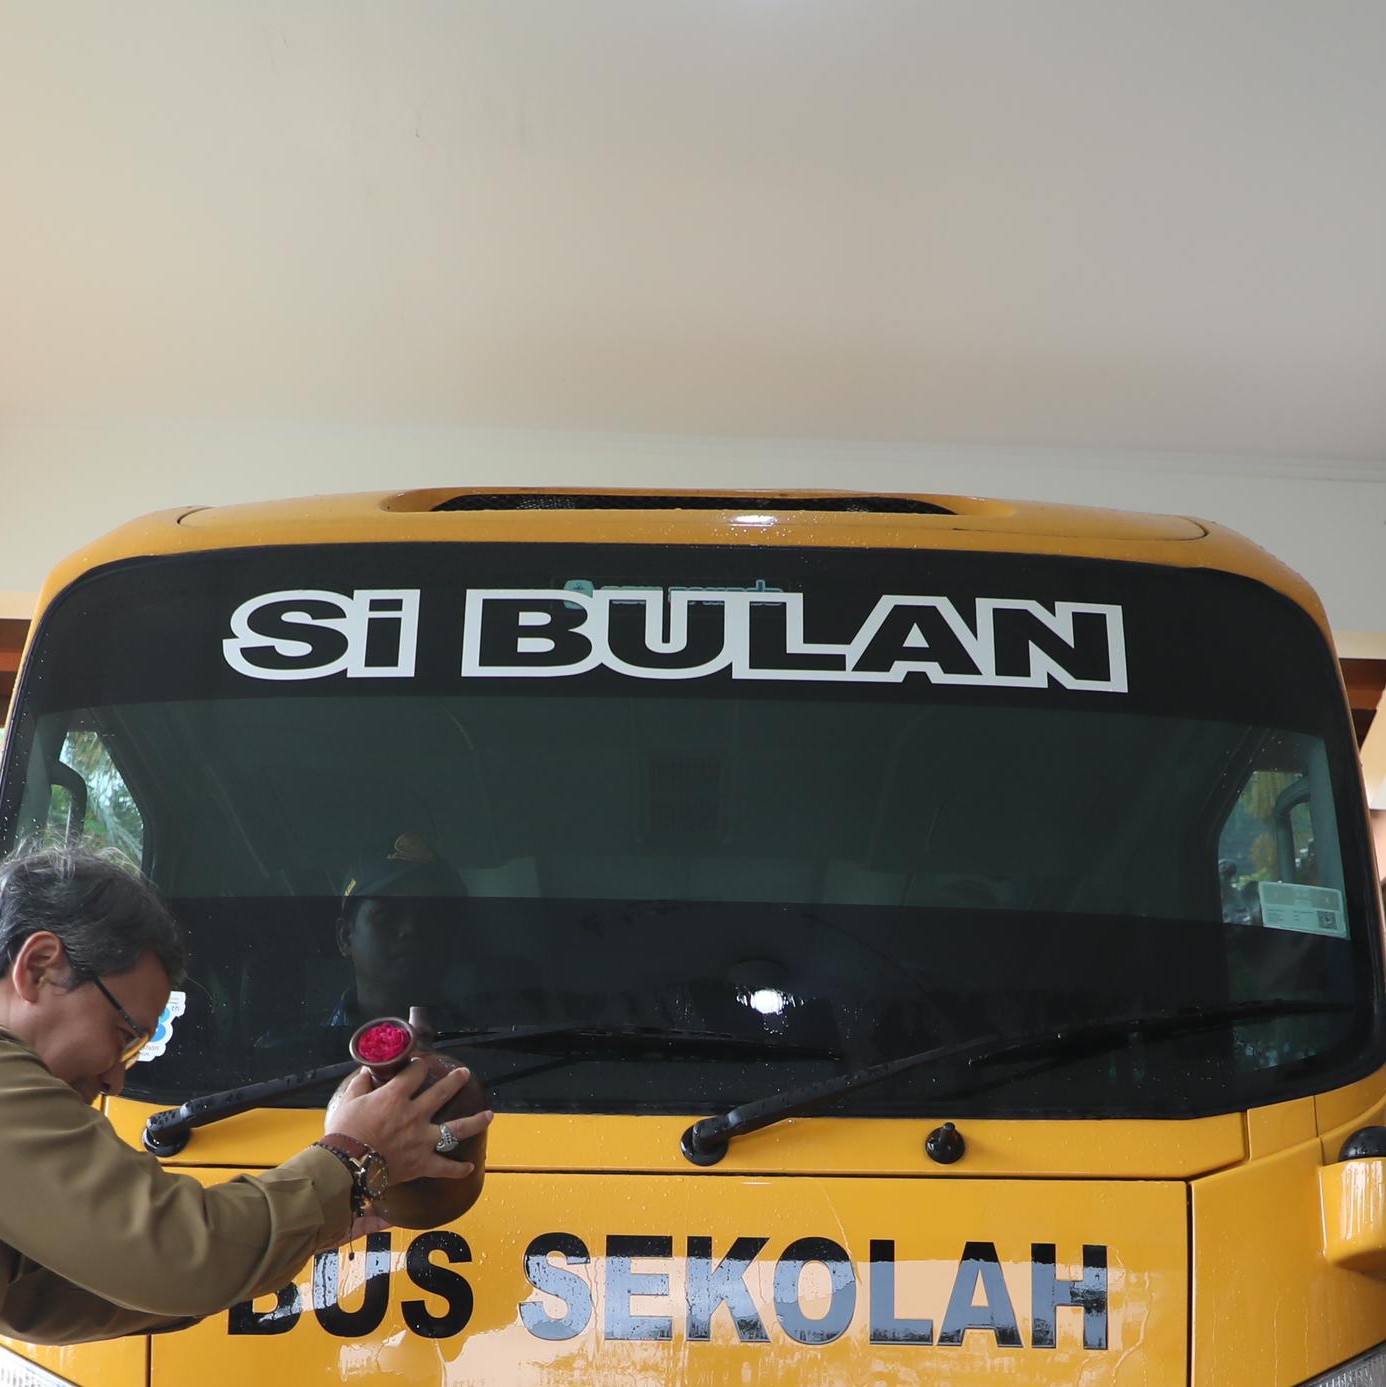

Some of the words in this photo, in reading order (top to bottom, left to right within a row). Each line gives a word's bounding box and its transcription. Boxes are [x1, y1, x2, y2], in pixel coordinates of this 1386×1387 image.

[222, 588, 421, 681] Si
[460, 588, 1129, 693] BULAN
[518, 1231, 1108, 1351] SEKOLAH
